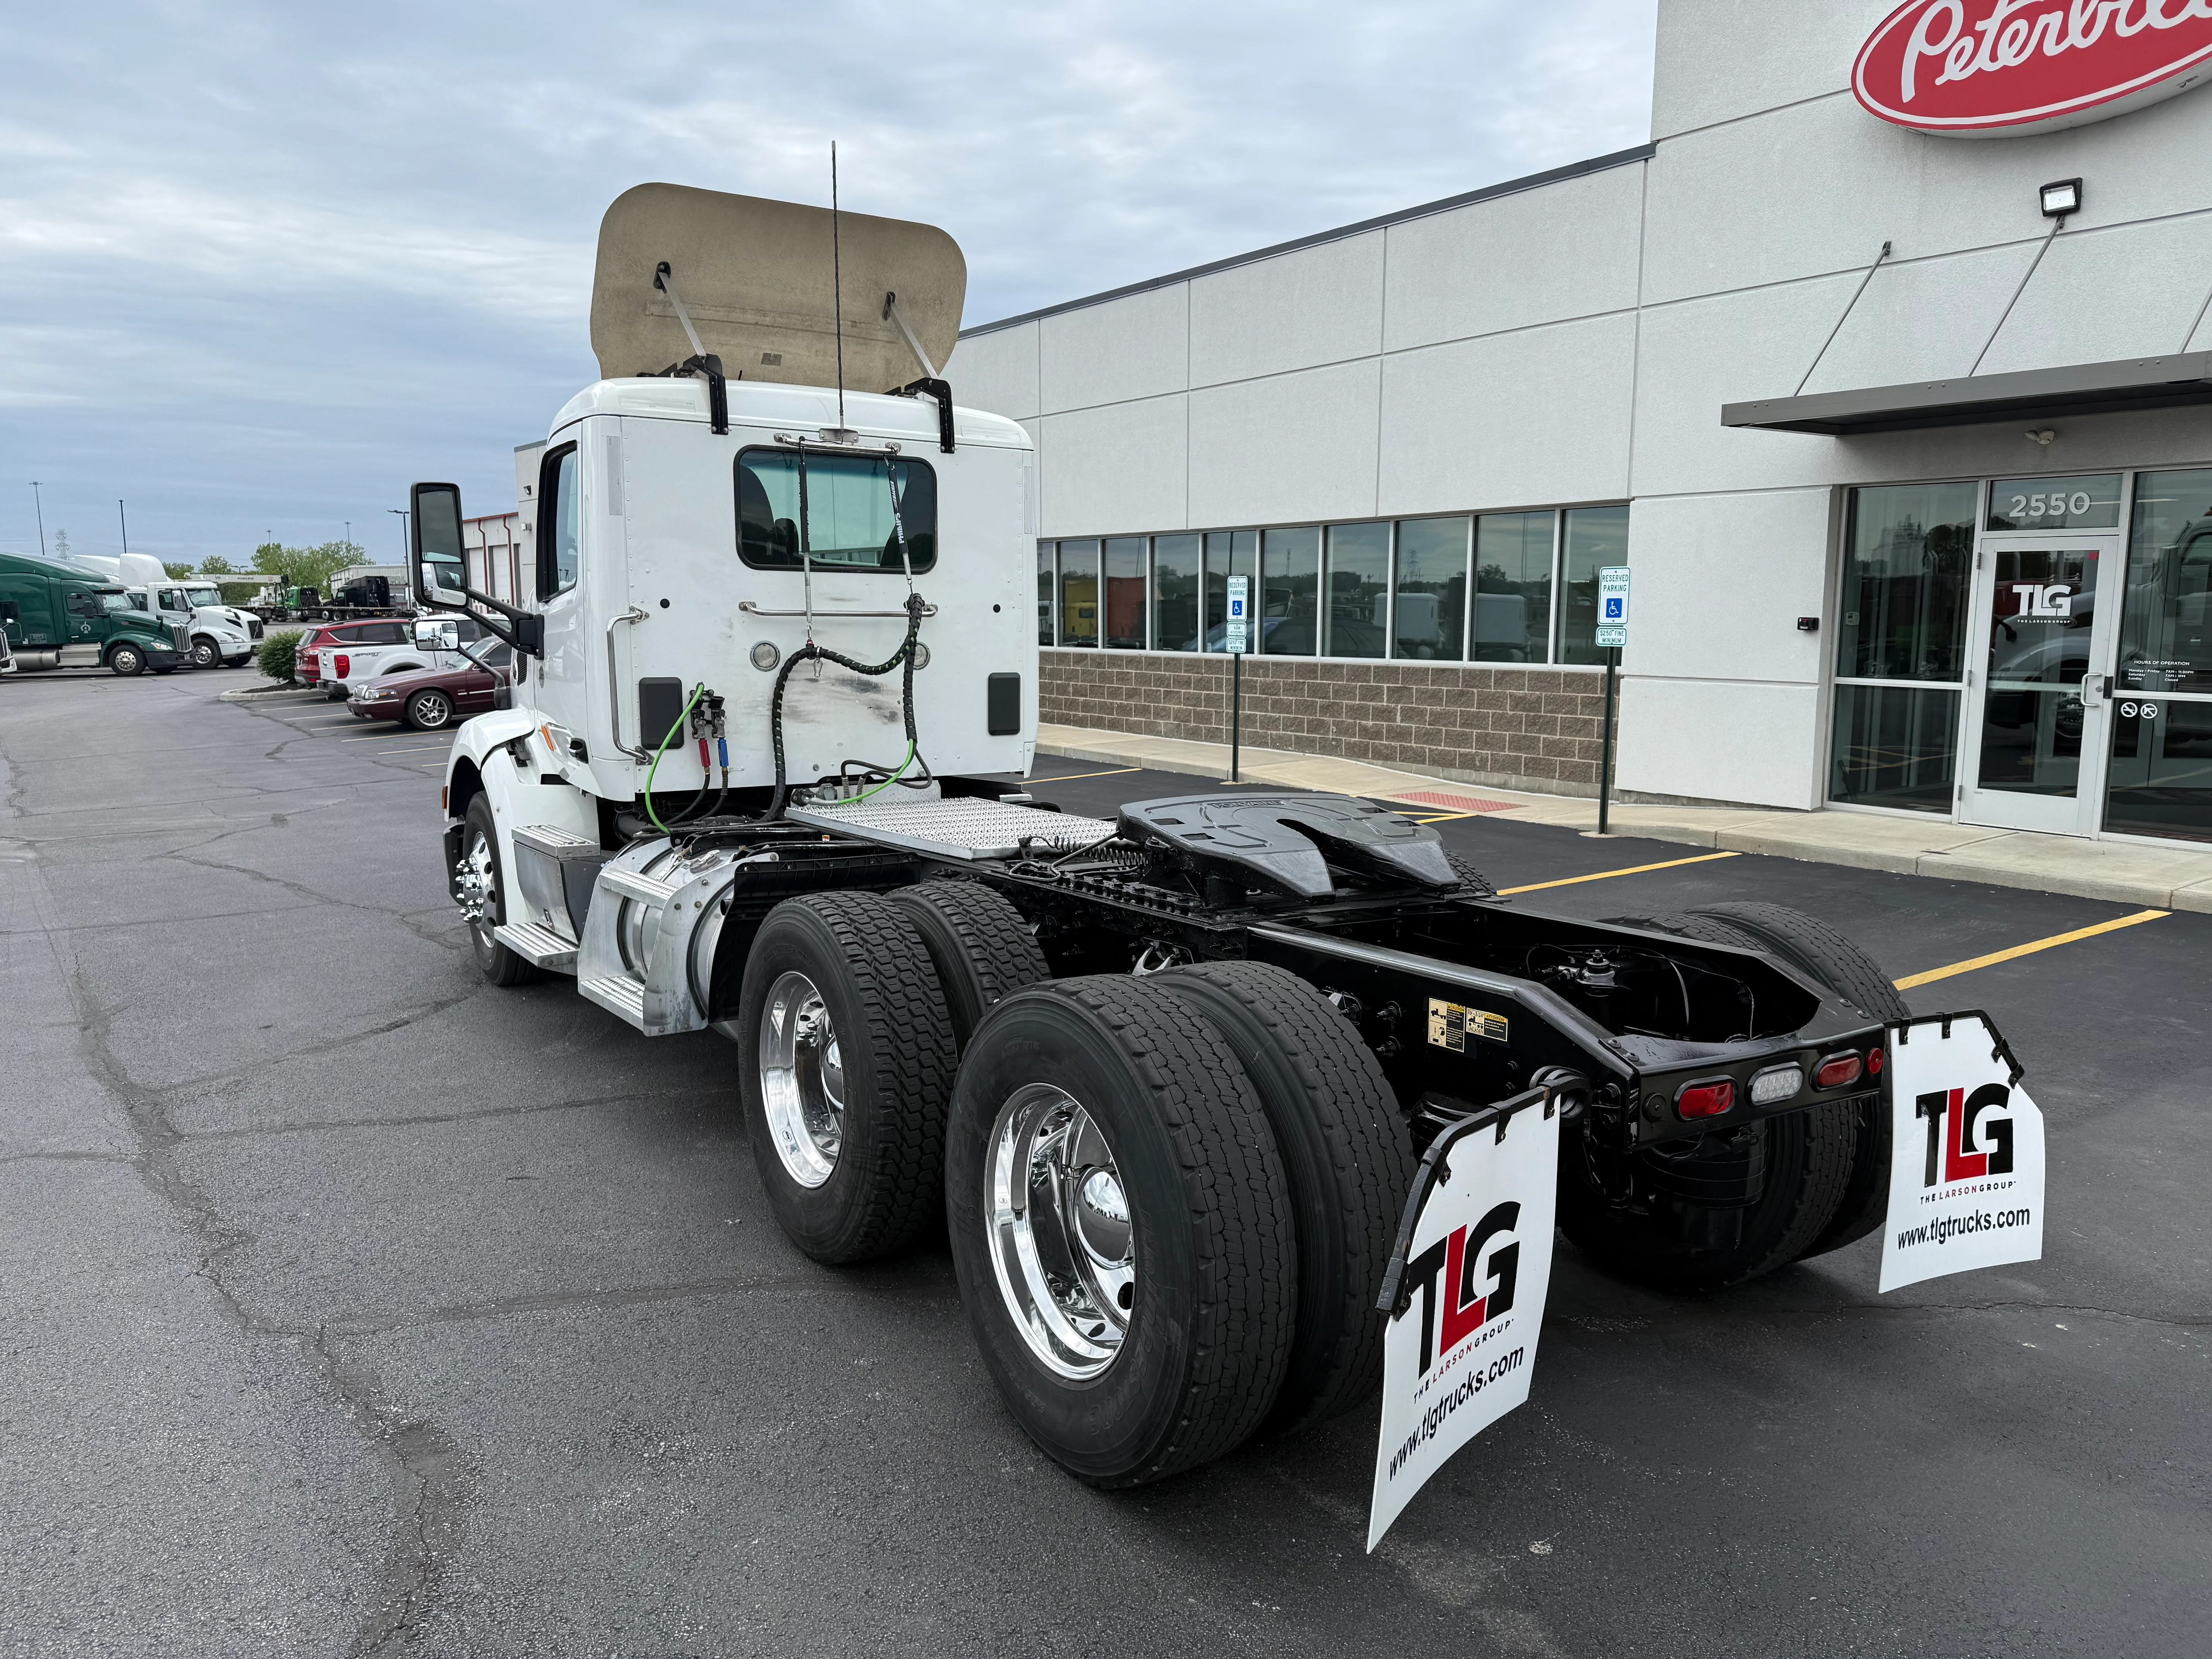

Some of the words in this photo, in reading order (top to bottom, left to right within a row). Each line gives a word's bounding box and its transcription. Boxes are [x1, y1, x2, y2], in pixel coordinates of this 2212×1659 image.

[2009, 492, 2090, 517] 2550
[2013, 585, 2071, 616] TLG
[1916, 1083, 2013, 1188] TLG
[1920, 1193, 1936, 1205] THE
[1939, 1185, 1977, 1200] LARSON
[1979, 1181, 2013, 1192] GROUP
[1898, 1207, 2030, 1250] www.tlgtrucks.com
[1408, 1201, 1521, 1380] TLG
[1413, 1379, 1429, 1405] THE
[1433, 1342, 1472, 1384] LARSON
[1474, 1320, 1510, 1348] GROUP
[1389, 1346, 1524, 1481] www.tlgtrucks.com
